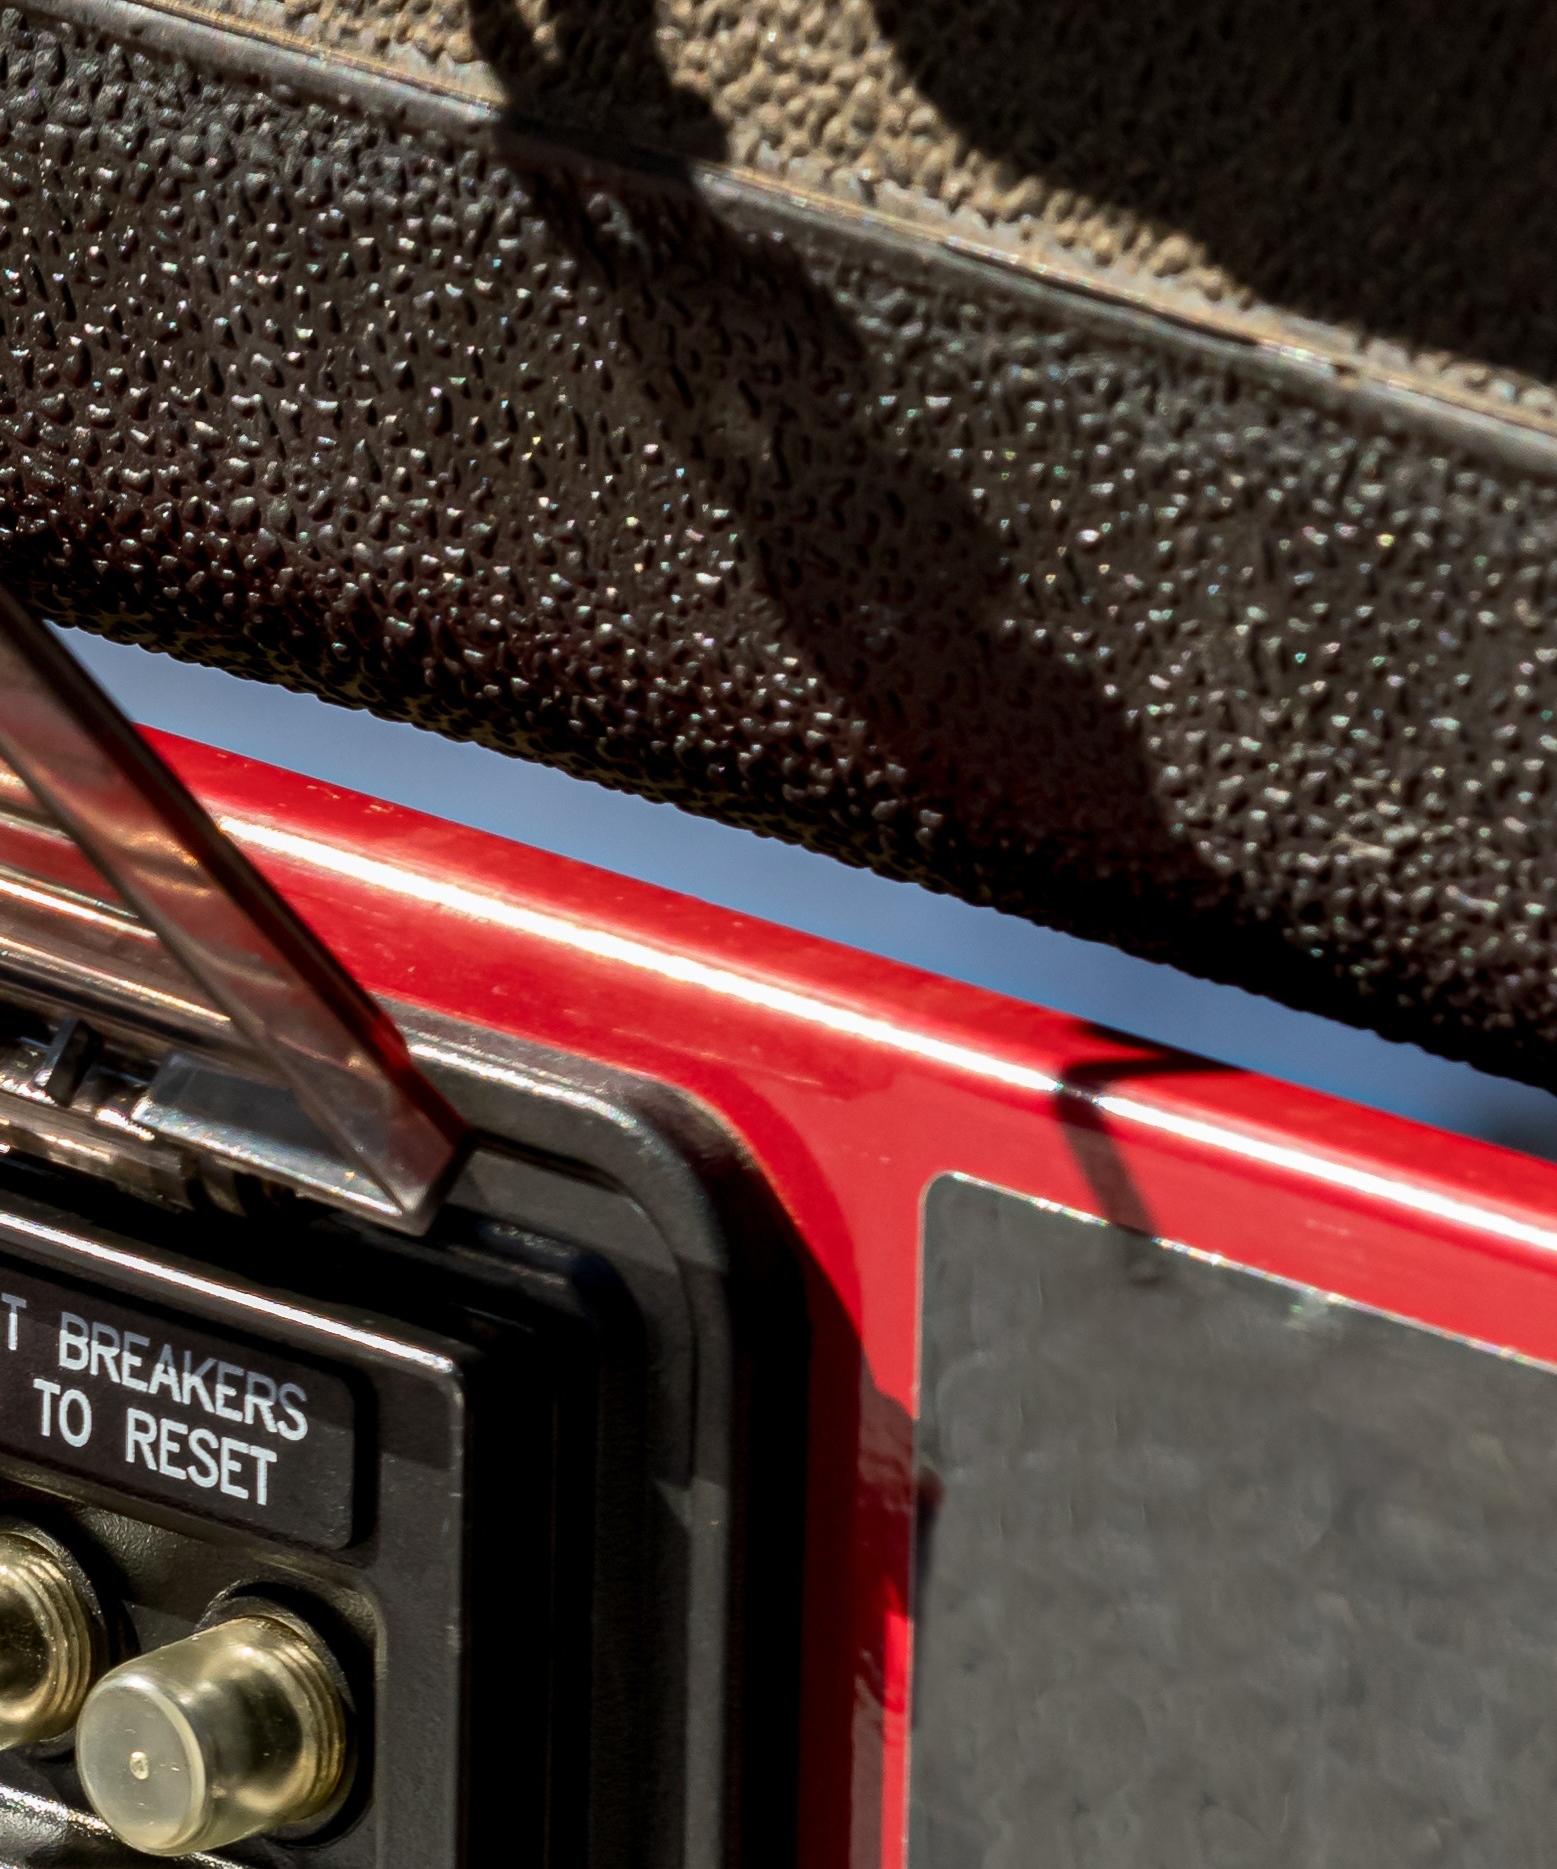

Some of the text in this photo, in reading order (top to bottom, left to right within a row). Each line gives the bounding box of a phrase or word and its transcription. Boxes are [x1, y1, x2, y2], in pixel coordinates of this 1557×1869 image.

[31, 1376, 93, 1449] TO
[124, 1406, 278, 1506] RESET
[57, 1311, 309, 1442] BREAKERS
